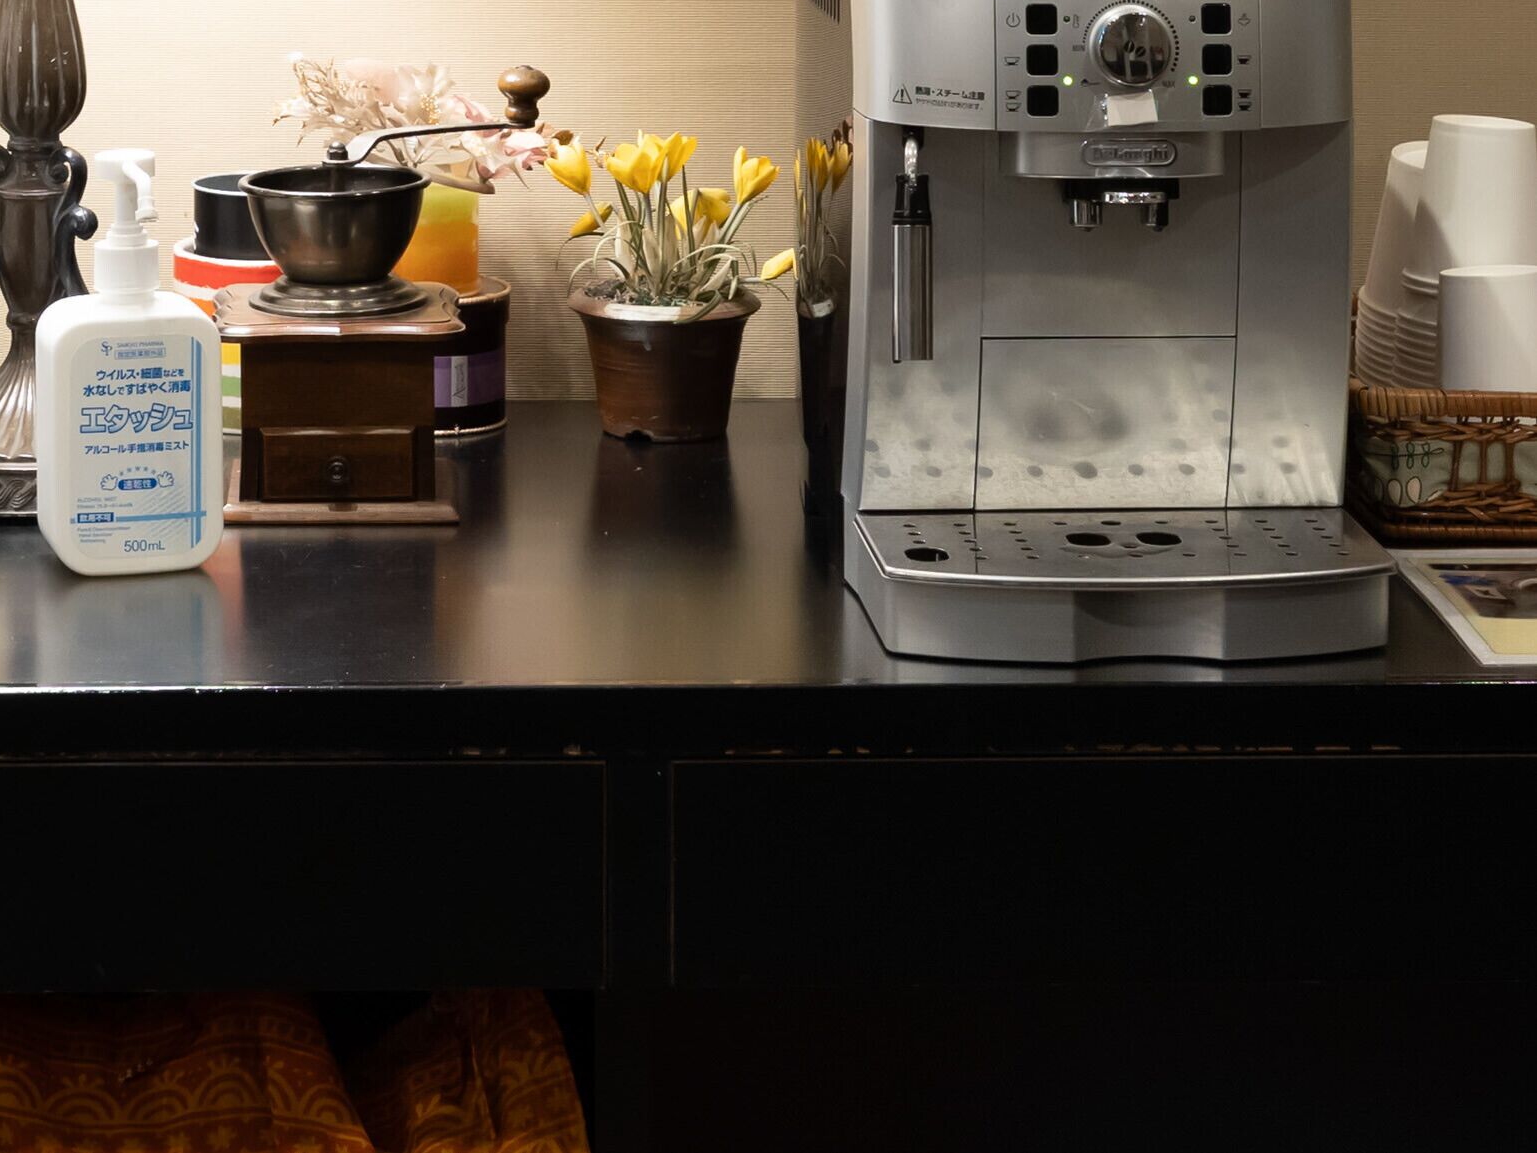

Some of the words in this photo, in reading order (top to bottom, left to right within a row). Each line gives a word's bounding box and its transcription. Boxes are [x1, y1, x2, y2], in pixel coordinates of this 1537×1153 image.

[96, 367, 185, 381] ウイルス・細菌などを
[83, 380, 192, 397] 水なしですばやく消毒
[80, 402, 194, 434] エタッシュ
[124, 539, 165, 552] 500mL
